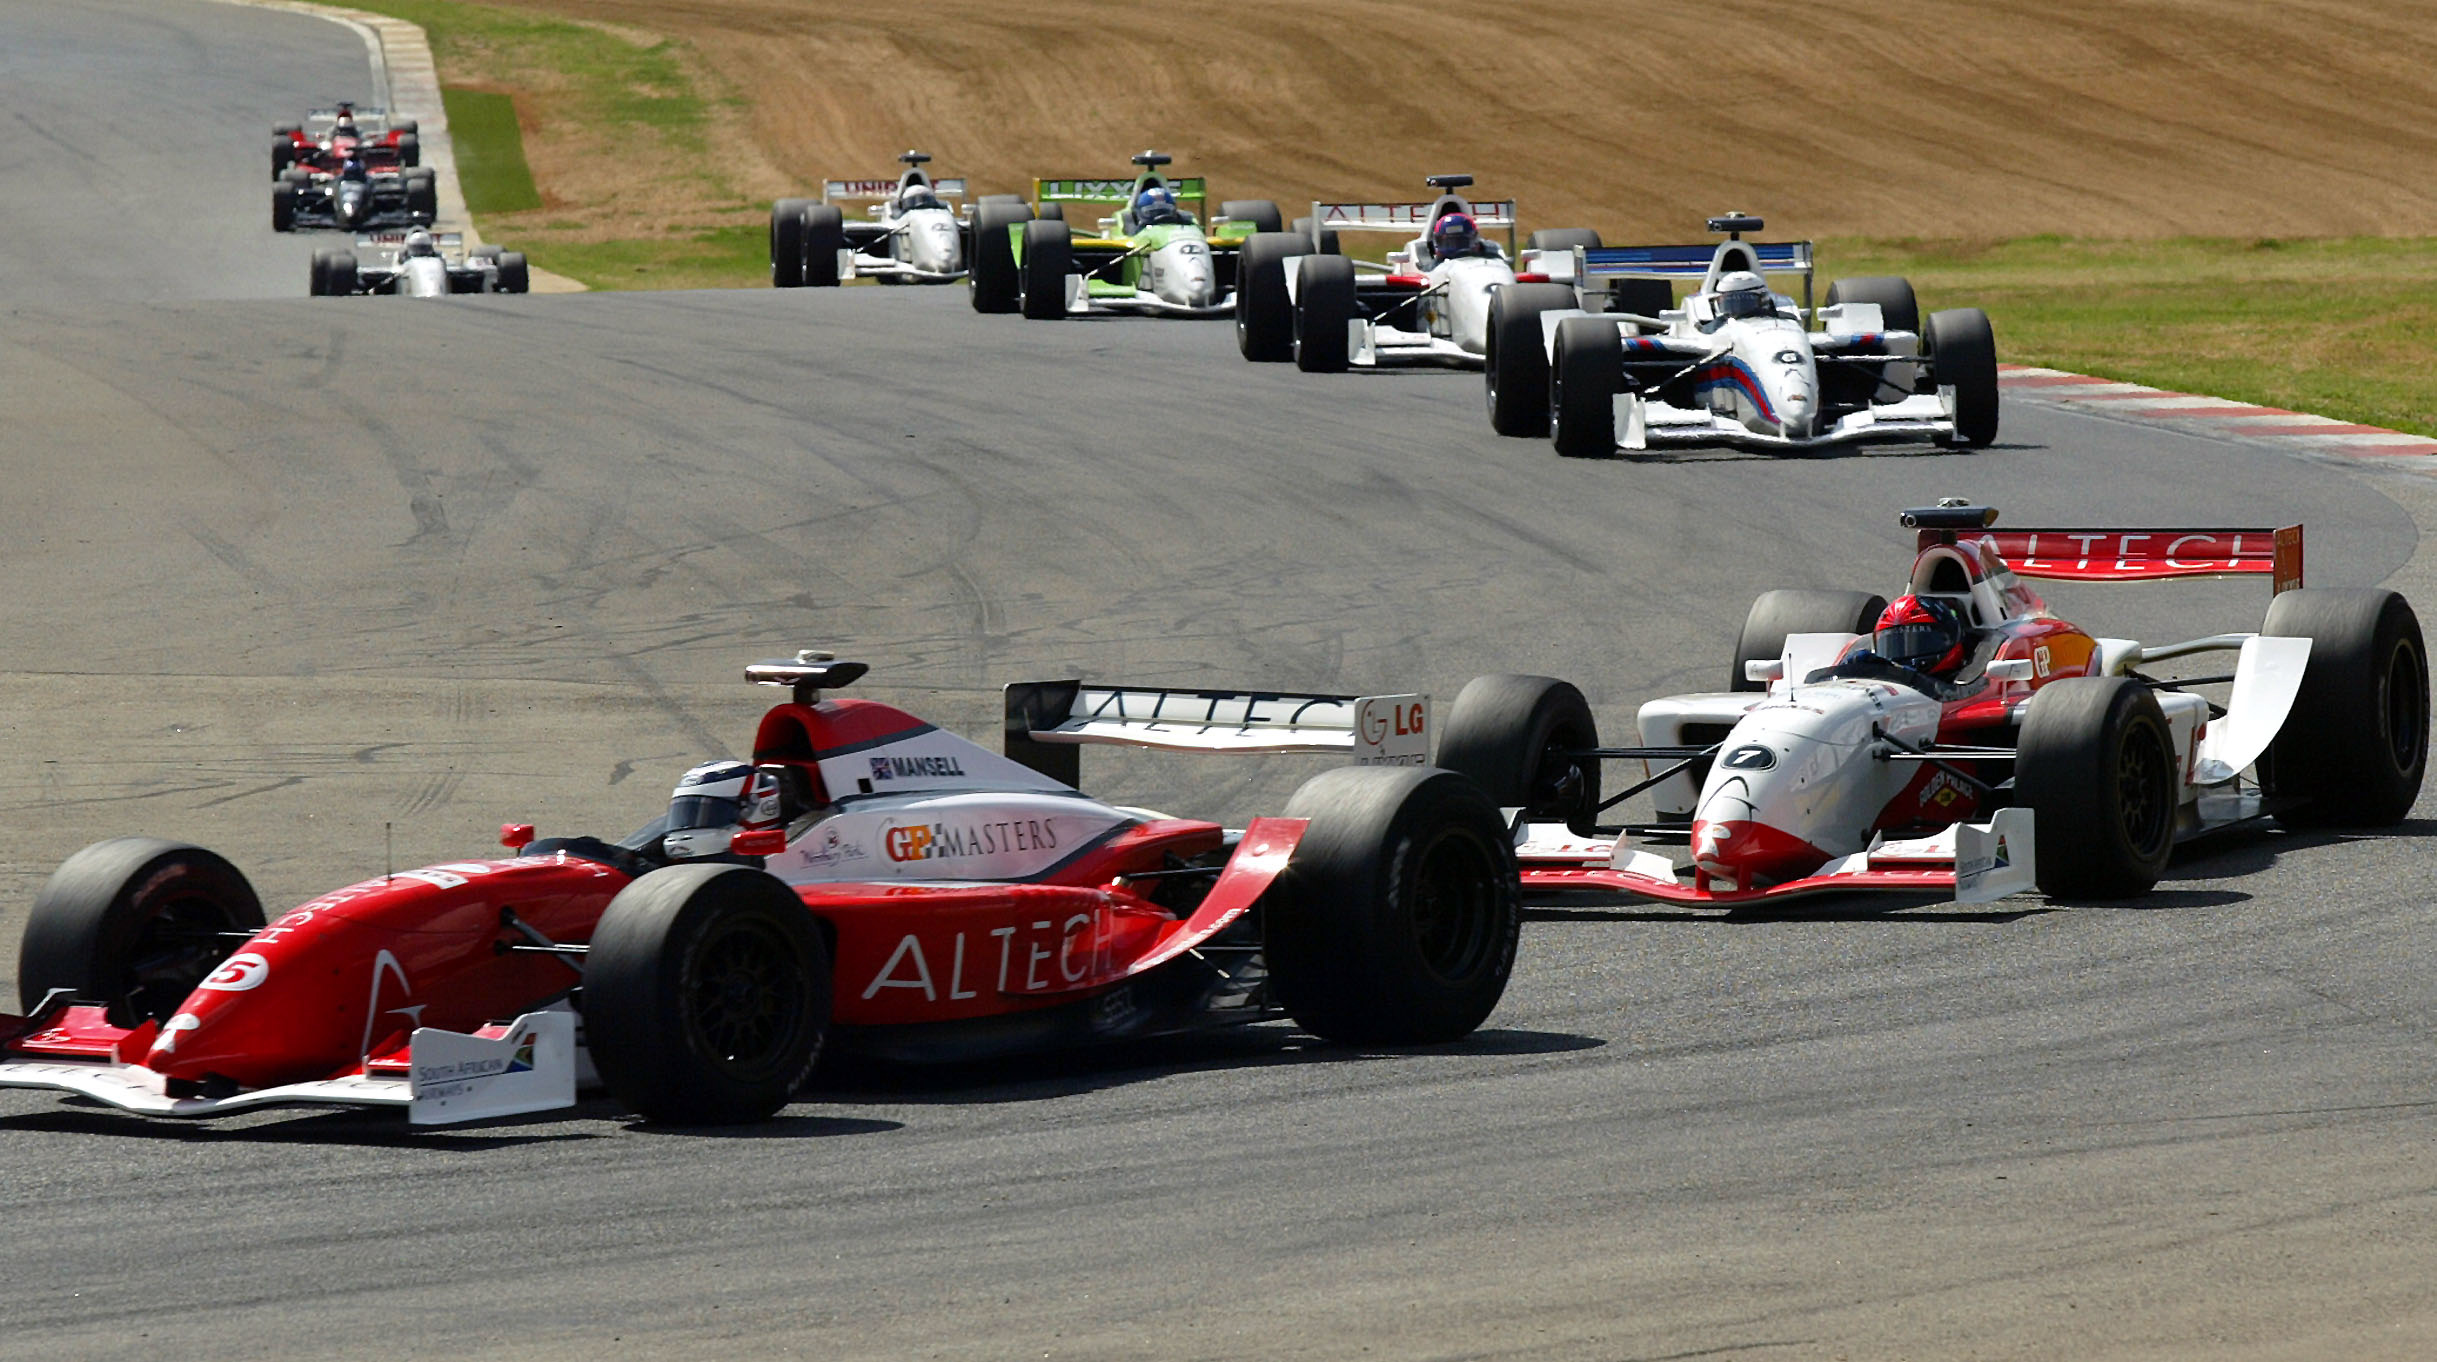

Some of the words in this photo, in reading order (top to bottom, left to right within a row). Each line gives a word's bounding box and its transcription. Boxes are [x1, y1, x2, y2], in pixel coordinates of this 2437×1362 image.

[1325, 201, 1501, 222] ALTEH
[1075, 691, 1355, 738] ALTEC
[1395, 703, 1424, 736] LG
[891, 757, 965, 777] MANSELL
[1733, 750, 1762, 765] 7
[944, 818, 1057, 858] MASTERS
[862, 909, 1112, 1002] ALTECH
[209, 960, 259, 984] 5
